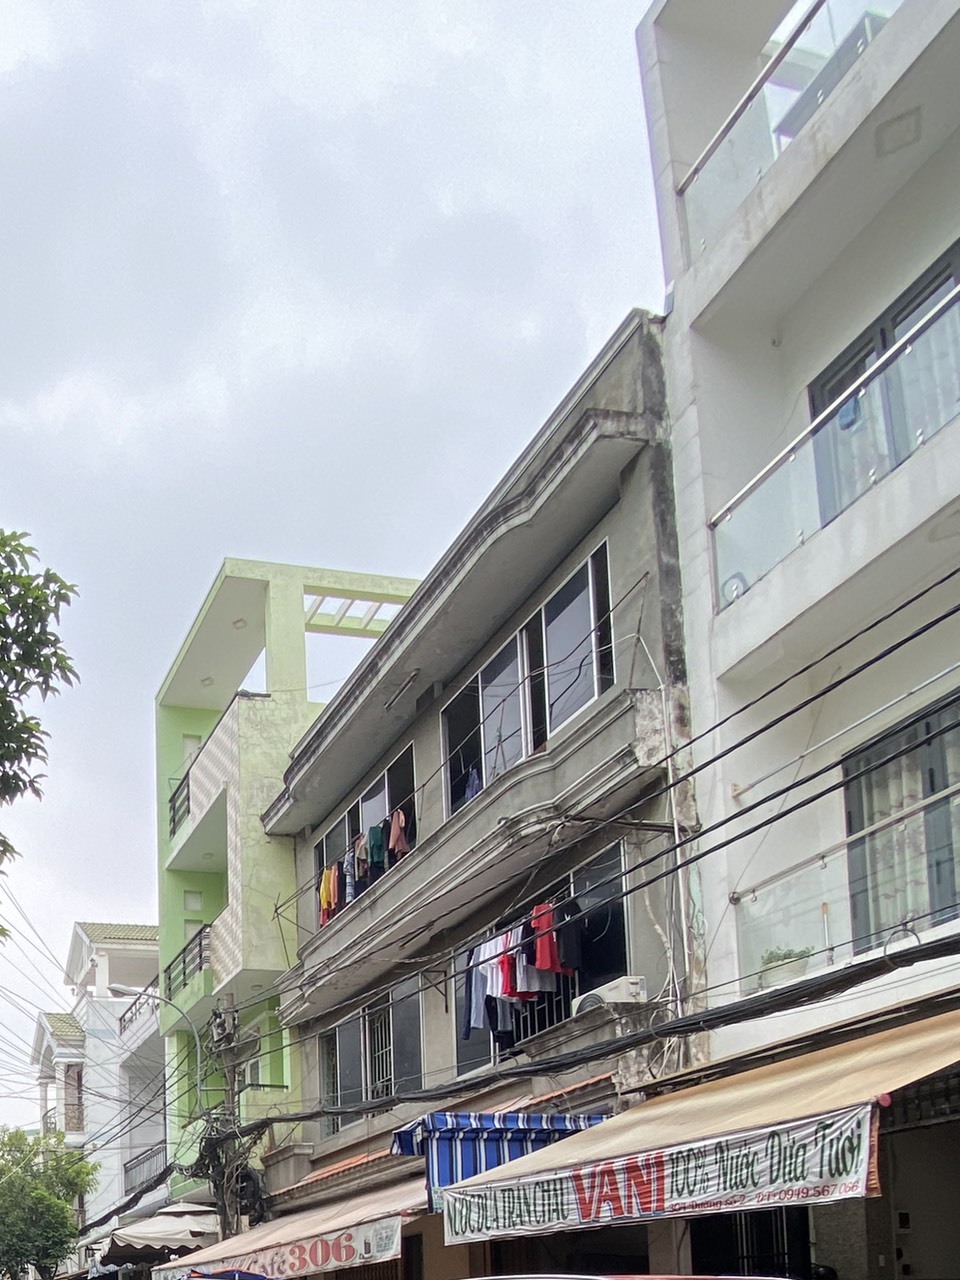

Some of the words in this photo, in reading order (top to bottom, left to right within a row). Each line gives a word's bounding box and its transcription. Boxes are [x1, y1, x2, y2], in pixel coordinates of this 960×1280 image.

[570, 1151, 665, 1223] VANI
[668, 1144, 710, 1198] 100%
[714, 1139, 761, 1192] Nước
[764, 1129, 809, 1185] Dừa
[814, 1117, 863, 1180] Tươi
[289, 1232, 356, 1272] 306
